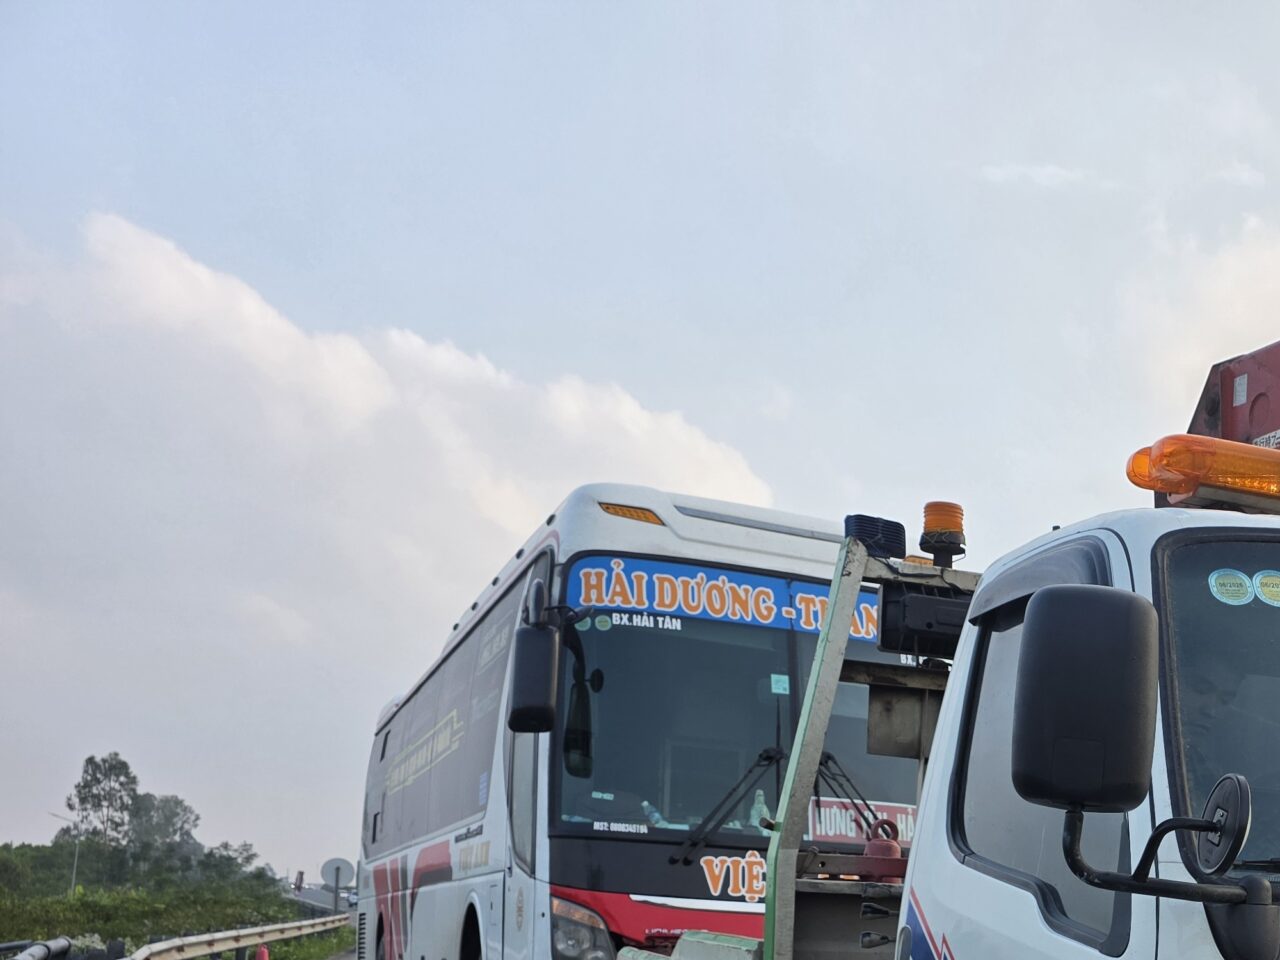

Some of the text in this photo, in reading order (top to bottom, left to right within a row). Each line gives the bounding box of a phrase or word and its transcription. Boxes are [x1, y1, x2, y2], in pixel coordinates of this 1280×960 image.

[579, 558, 648, 609] HẢI
[653, 572, 777, 624] DƯƠNG
[656, 615, 682, 630] TÂN
[700, 850, 766, 903] VIỆ
